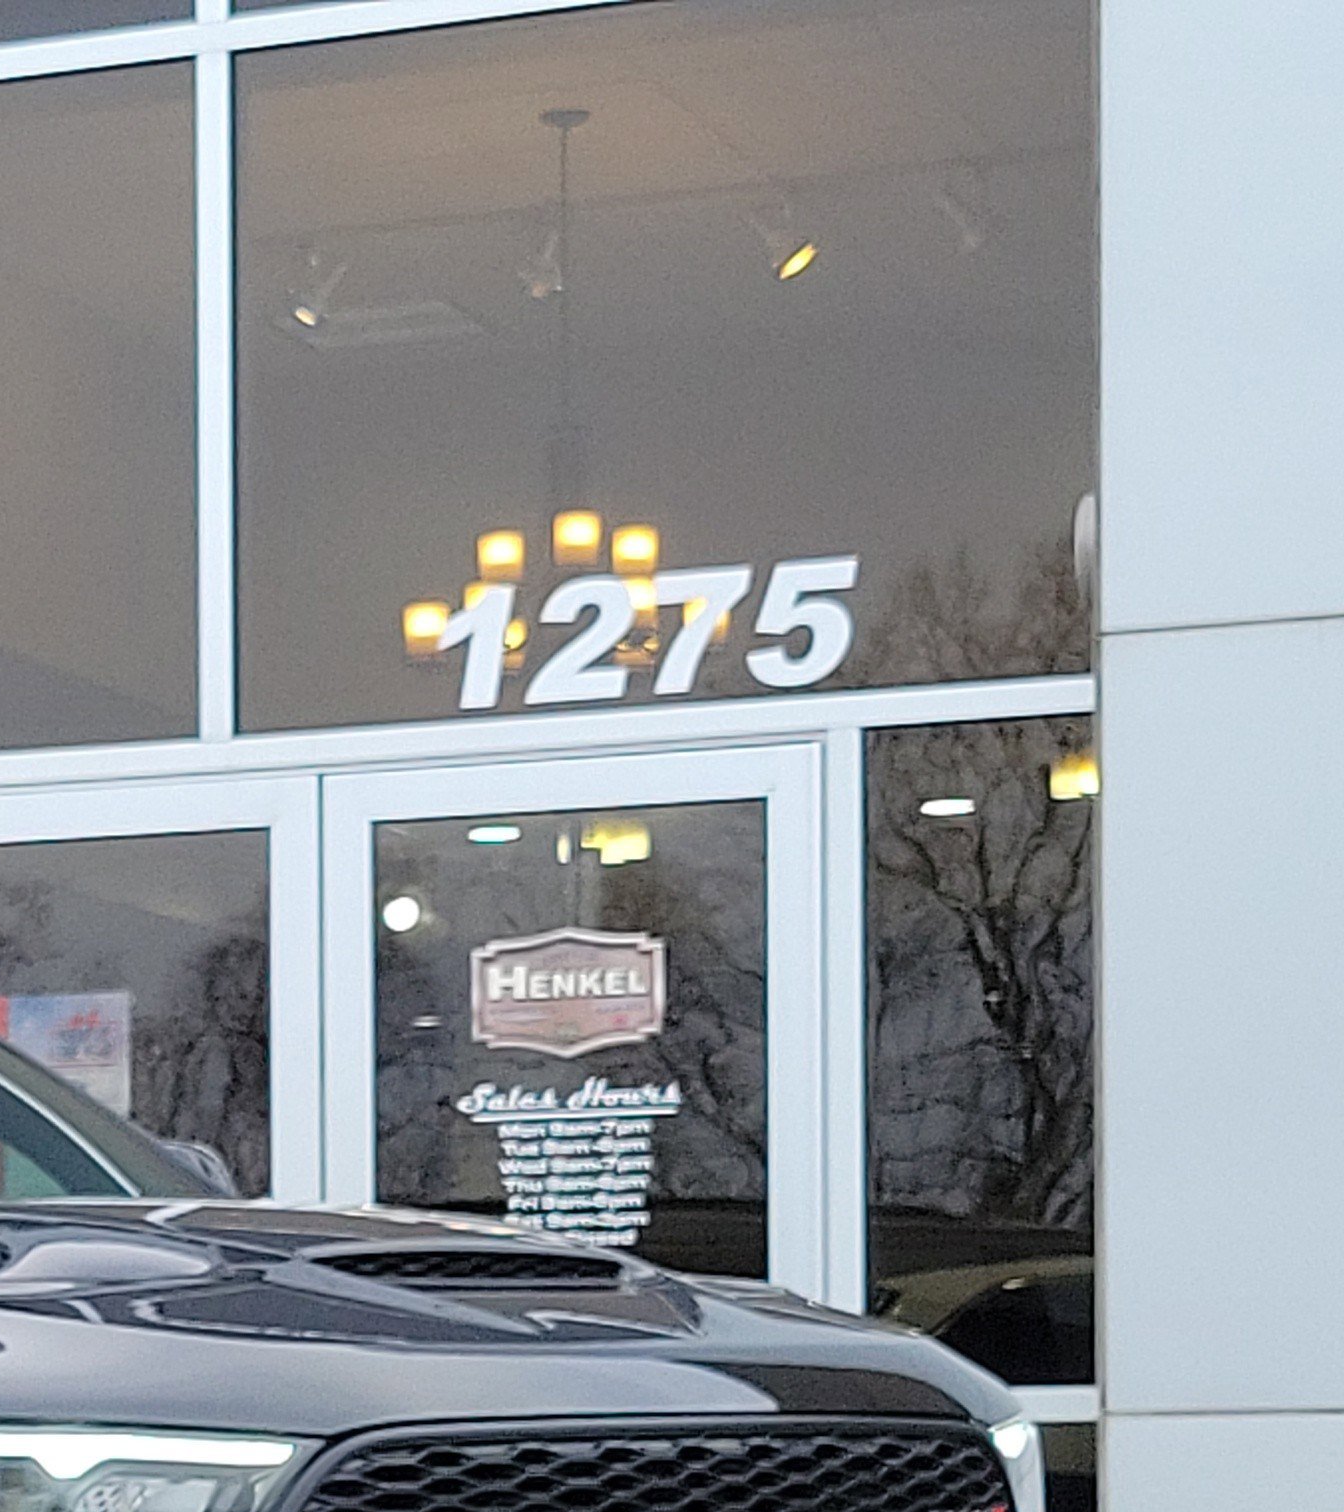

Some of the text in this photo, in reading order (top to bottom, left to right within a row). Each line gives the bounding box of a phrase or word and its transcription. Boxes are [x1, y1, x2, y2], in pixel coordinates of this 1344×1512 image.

[436, 555, 859, 710] 1275
[487, 965, 649, 1001] HENKEL
[456, 1075, 682, 1114] Sales Hours
